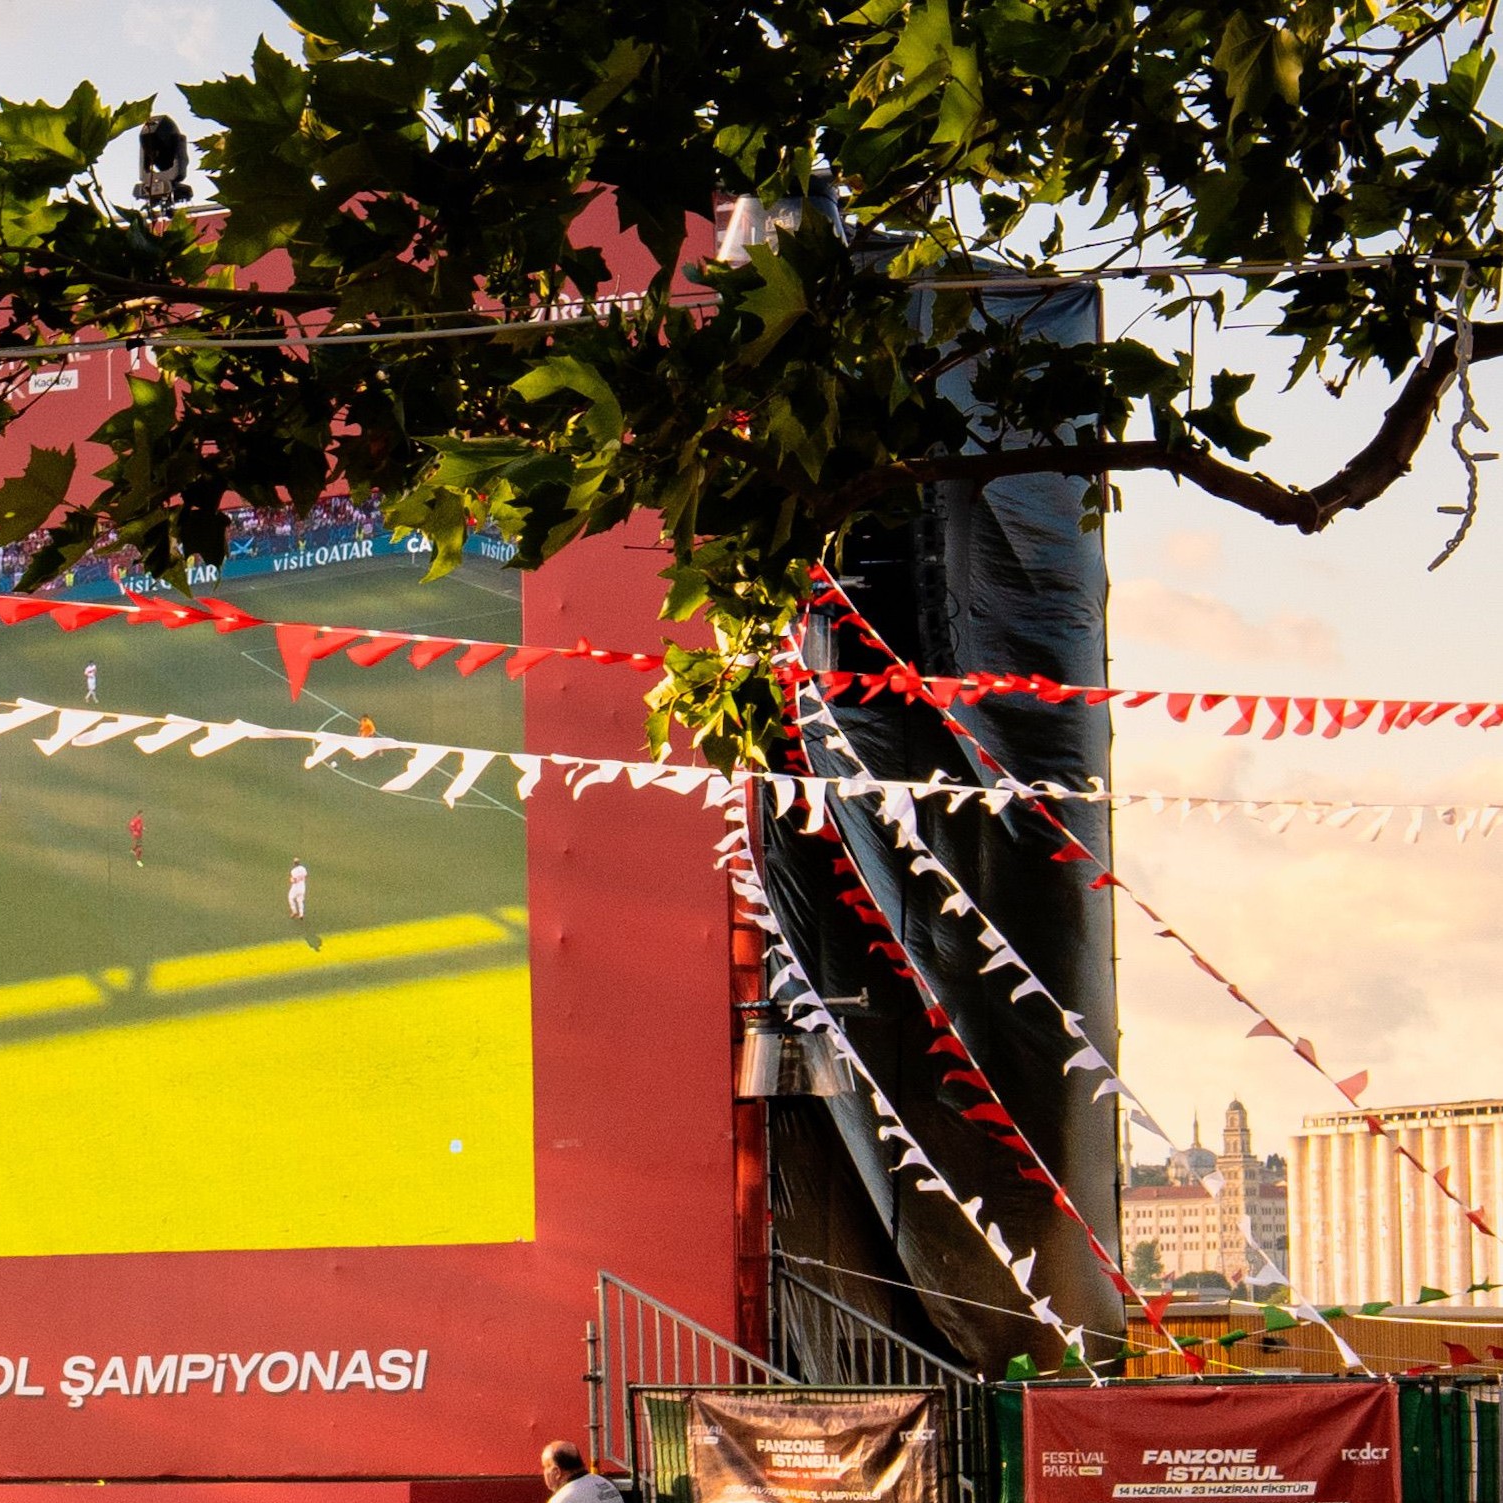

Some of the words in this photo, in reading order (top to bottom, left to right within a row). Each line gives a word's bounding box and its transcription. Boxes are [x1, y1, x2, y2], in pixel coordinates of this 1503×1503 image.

[756, 1439, 825, 1453] FANZONE
[1042, 1449, 1109, 1465] FESTİVAL
[1142, 1449, 1257, 1465] FANZONE
[1042, 1466, 1078, 1478] PARK
[1133, 1485, 1182, 1495] HAZİRAN
[1191, 1486, 1205, 1495] 23
[1208, 1484, 1259, 1495] HAZİRAN
[1261, 1483, 1309, 1494] FİKSTÜR
